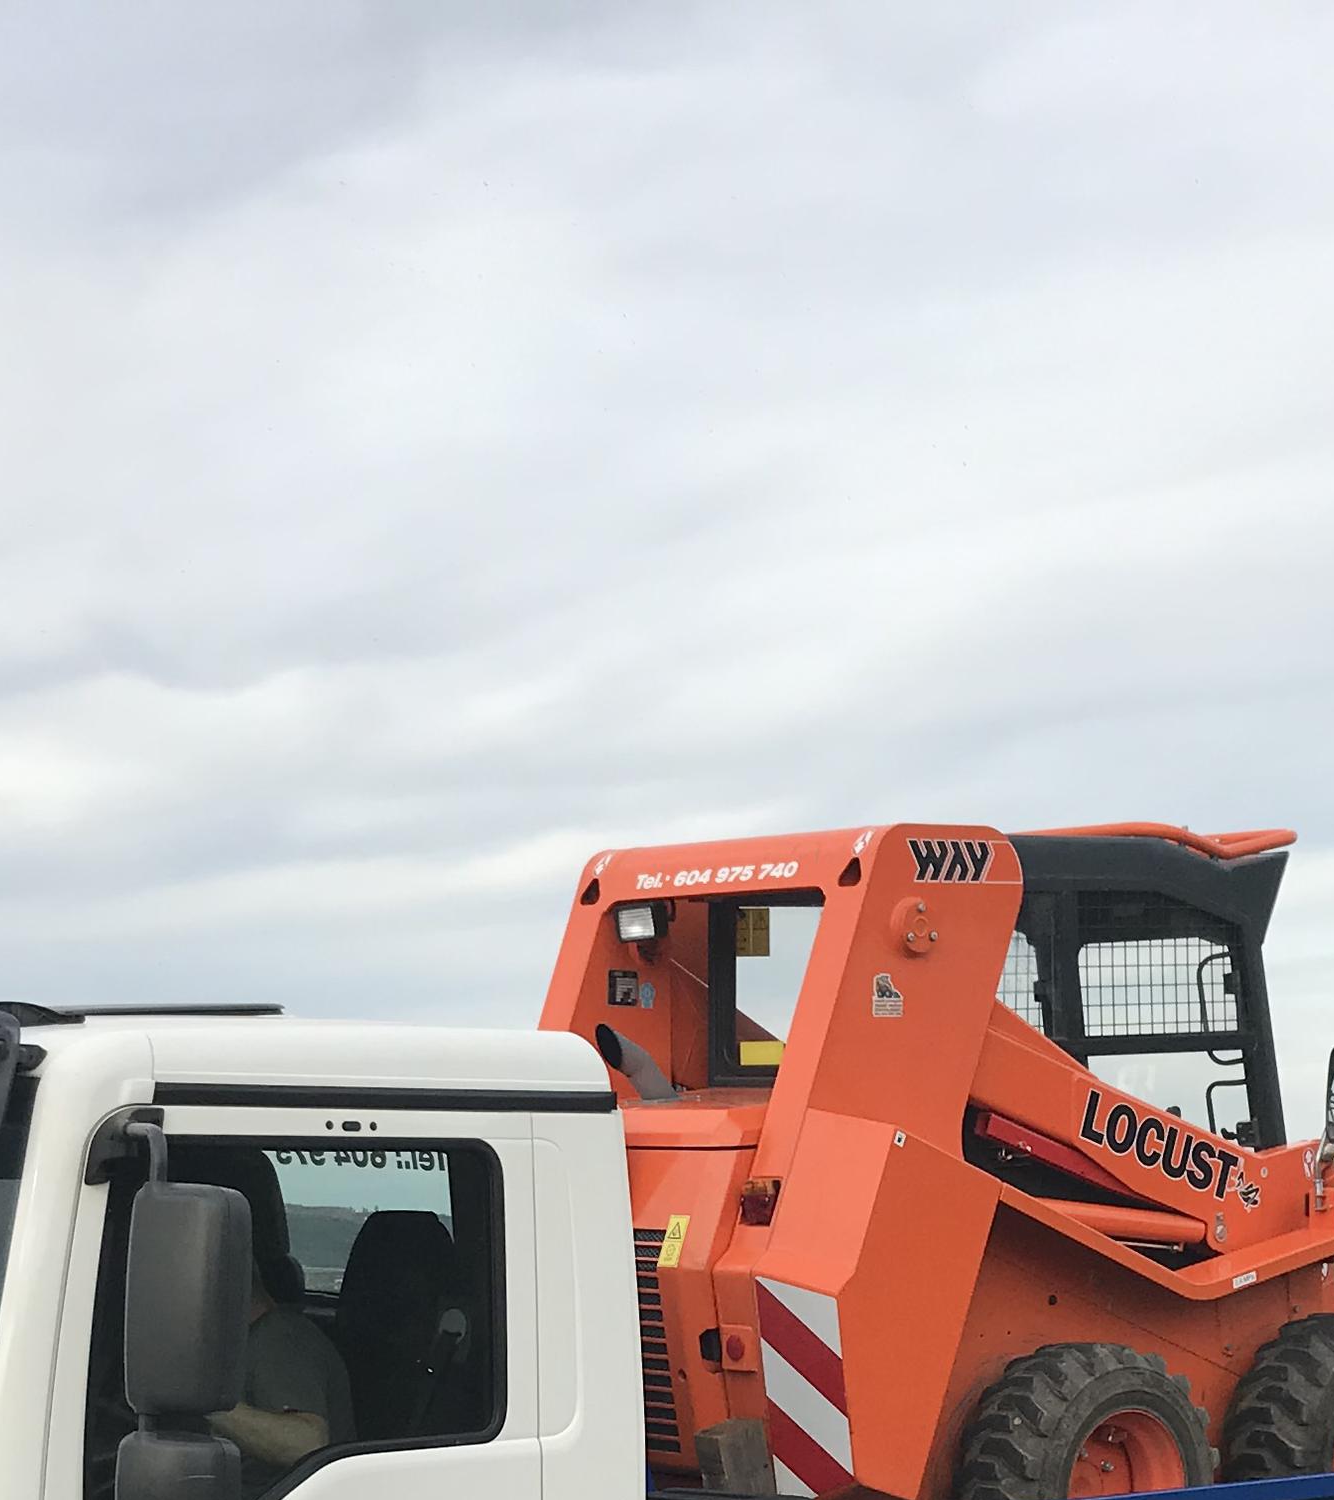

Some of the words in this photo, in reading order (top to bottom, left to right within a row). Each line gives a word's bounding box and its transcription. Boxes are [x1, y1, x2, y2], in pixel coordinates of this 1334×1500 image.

[673, 869, 712, 887] 604
[715, 865, 755, 883] 975
[758, 861, 799, 880] 740
[906, 838, 992, 883] WAY
[1079, 1087, 1240, 1201] LOCUST
